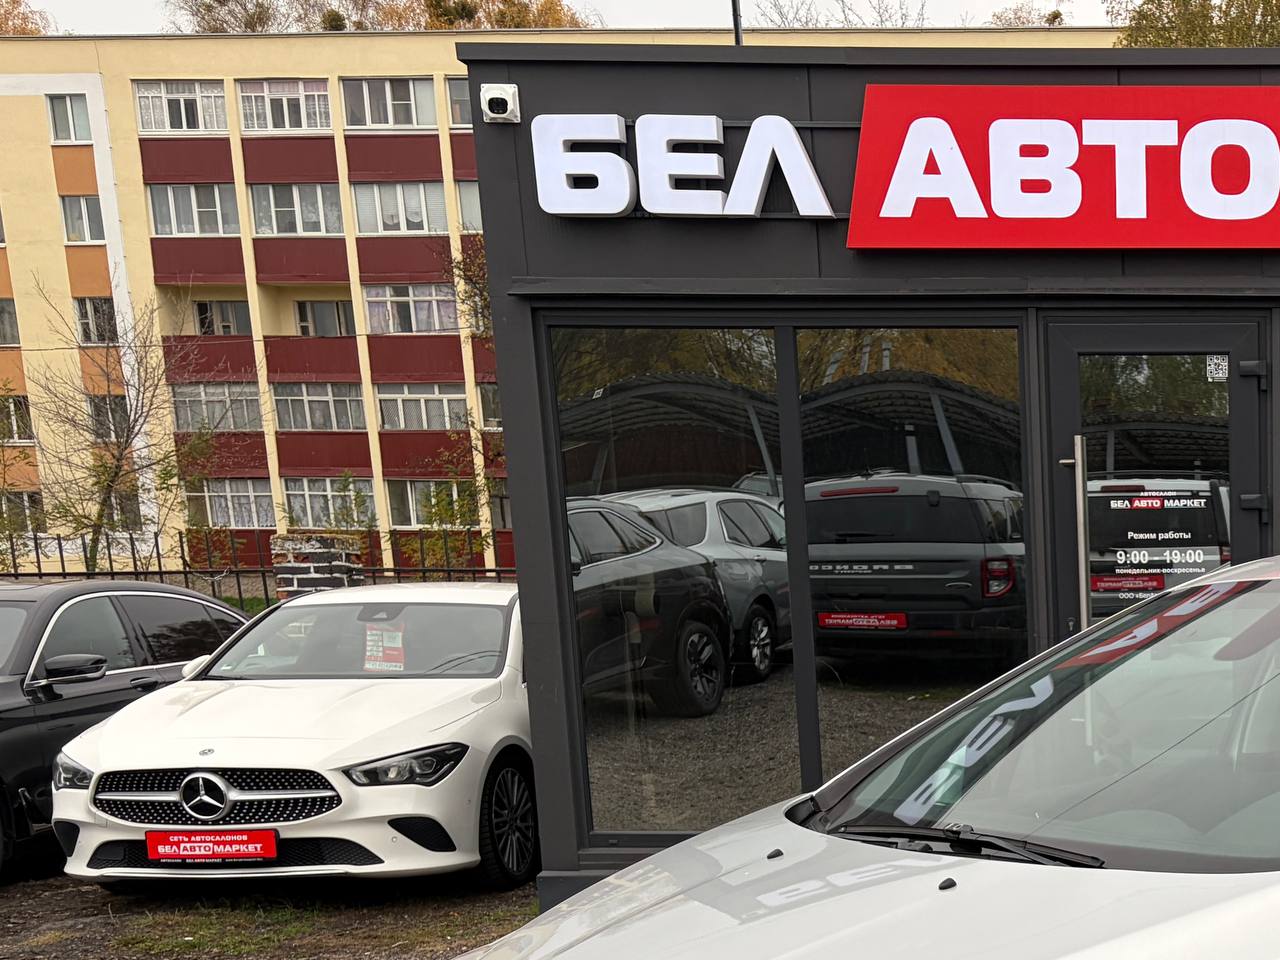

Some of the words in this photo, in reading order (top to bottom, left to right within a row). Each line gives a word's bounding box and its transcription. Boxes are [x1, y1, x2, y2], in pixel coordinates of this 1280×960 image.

[531, 113, 835, 217] БЕЛ
[1110, 500, 1131, 509] БЕЛ
[1132, 499, 1161, 508] АВТО
[1164, 499, 1207, 508] МАРКЕТ
[1127, 531, 1157, 540] Режим
[1158, 530, 1192, 541] работы
[1116, 550, 1149, 564] 9:00
[1163, 549, 1204, 563] 19:00
[1115, 567, 1206, 576] понедельник-воскресенье
[190, 834, 248, 842] АВТОСАЛОНОВ
[157, 845, 179, 853] БЕЛ
[181, 844, 212, 853] АВТО
[213, 843, 263, 853] МАРКЕТ
